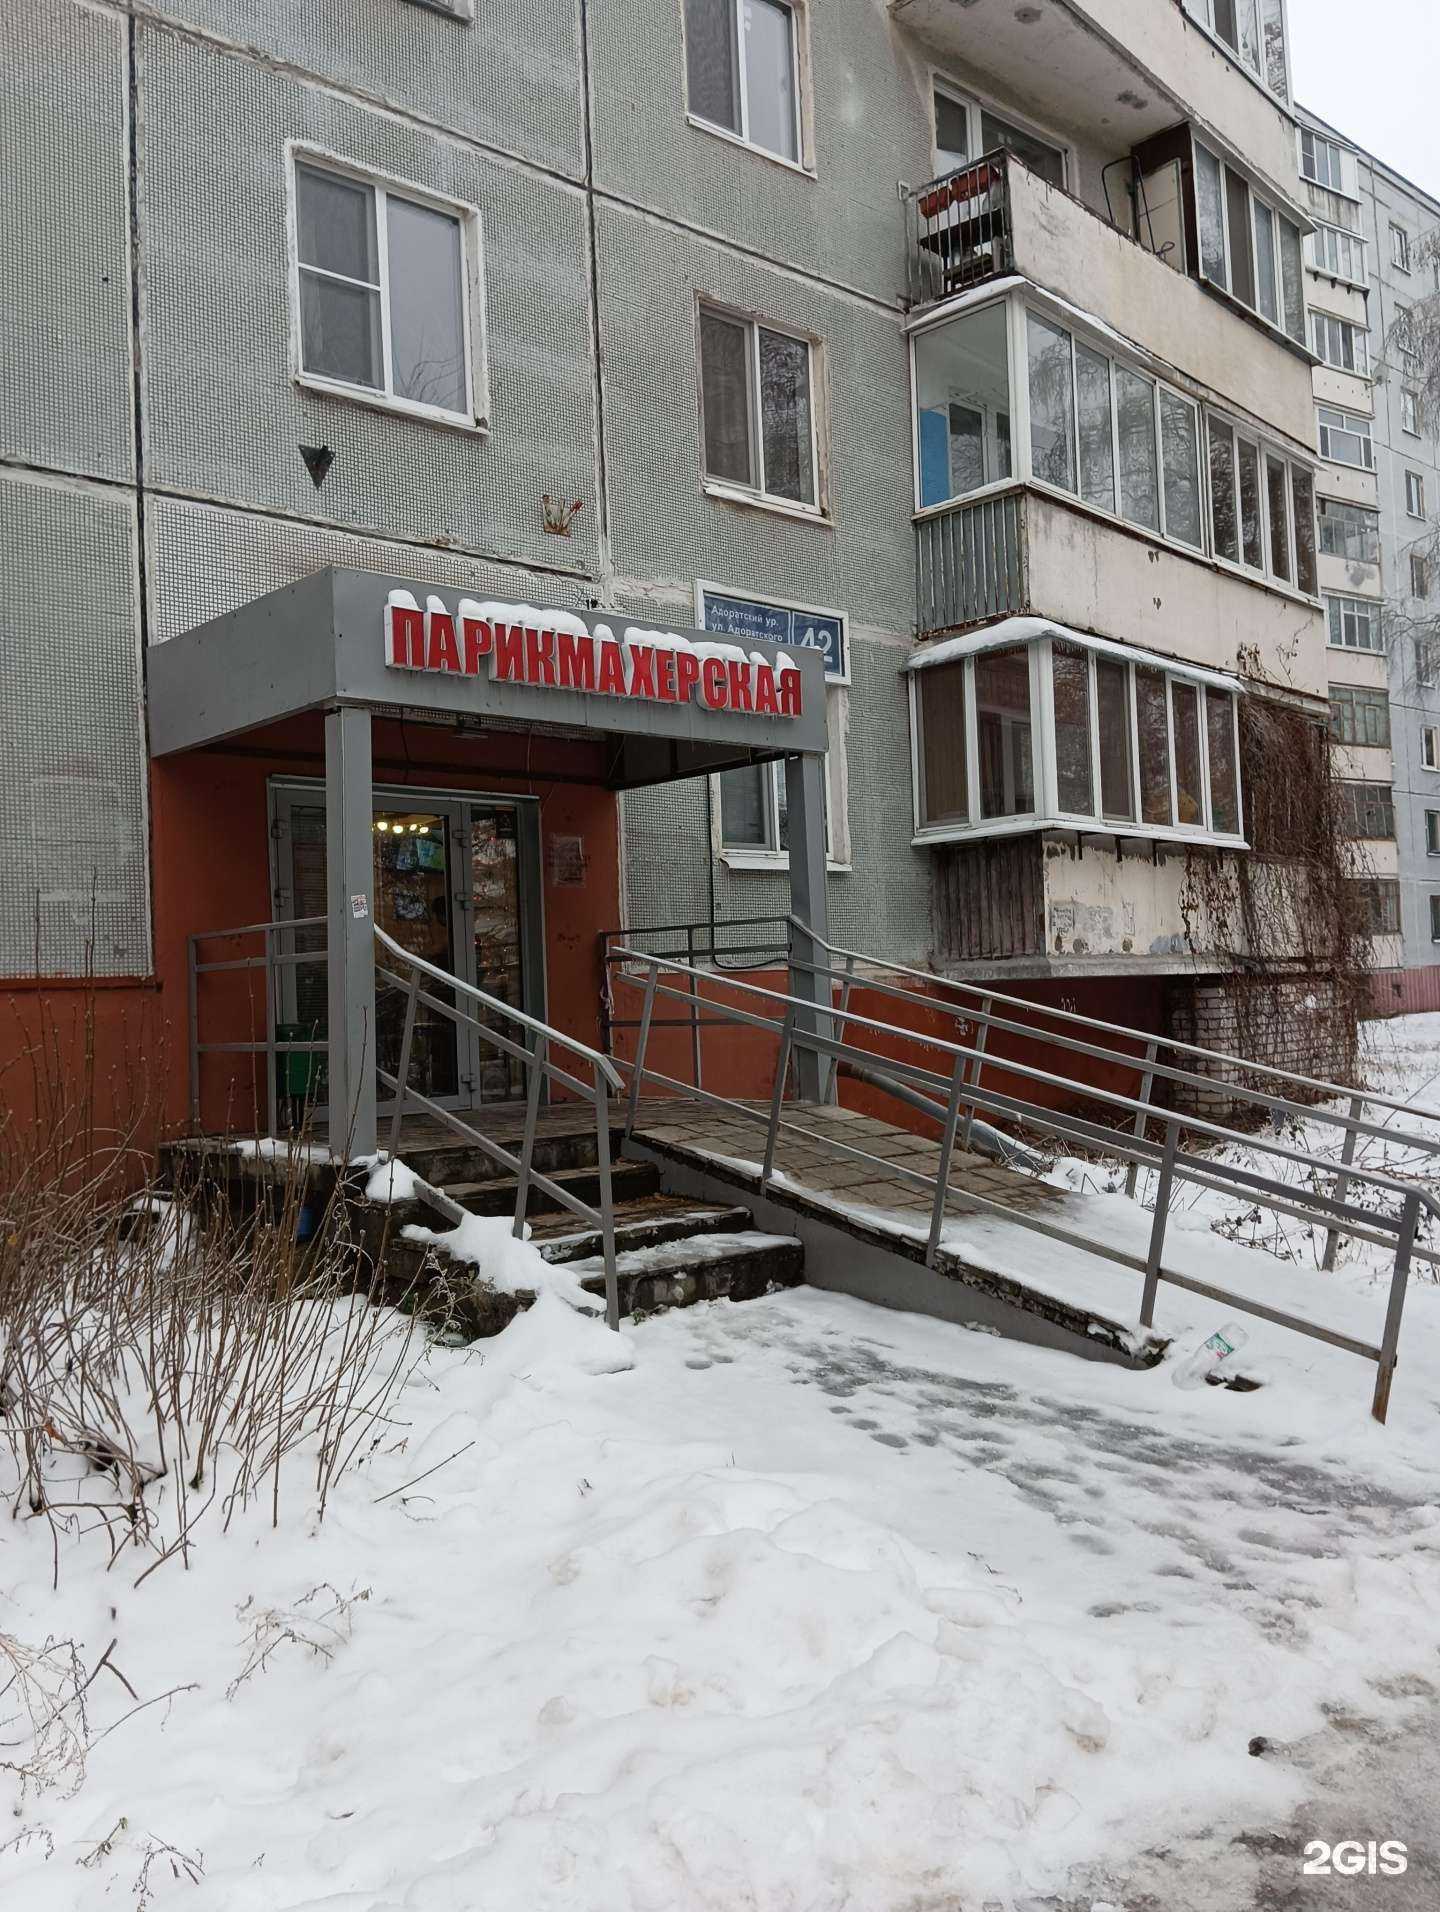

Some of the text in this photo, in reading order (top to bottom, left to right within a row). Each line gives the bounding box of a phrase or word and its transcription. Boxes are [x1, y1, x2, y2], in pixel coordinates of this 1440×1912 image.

[711, 605, 779, 628] Адоратский ур.
[711, 622, 783, 642] ул. Адоратского
[800, 627, 833, 663] 42
[386, 604, 802, 718] ПАРИКМАХЕРСКАЯ
